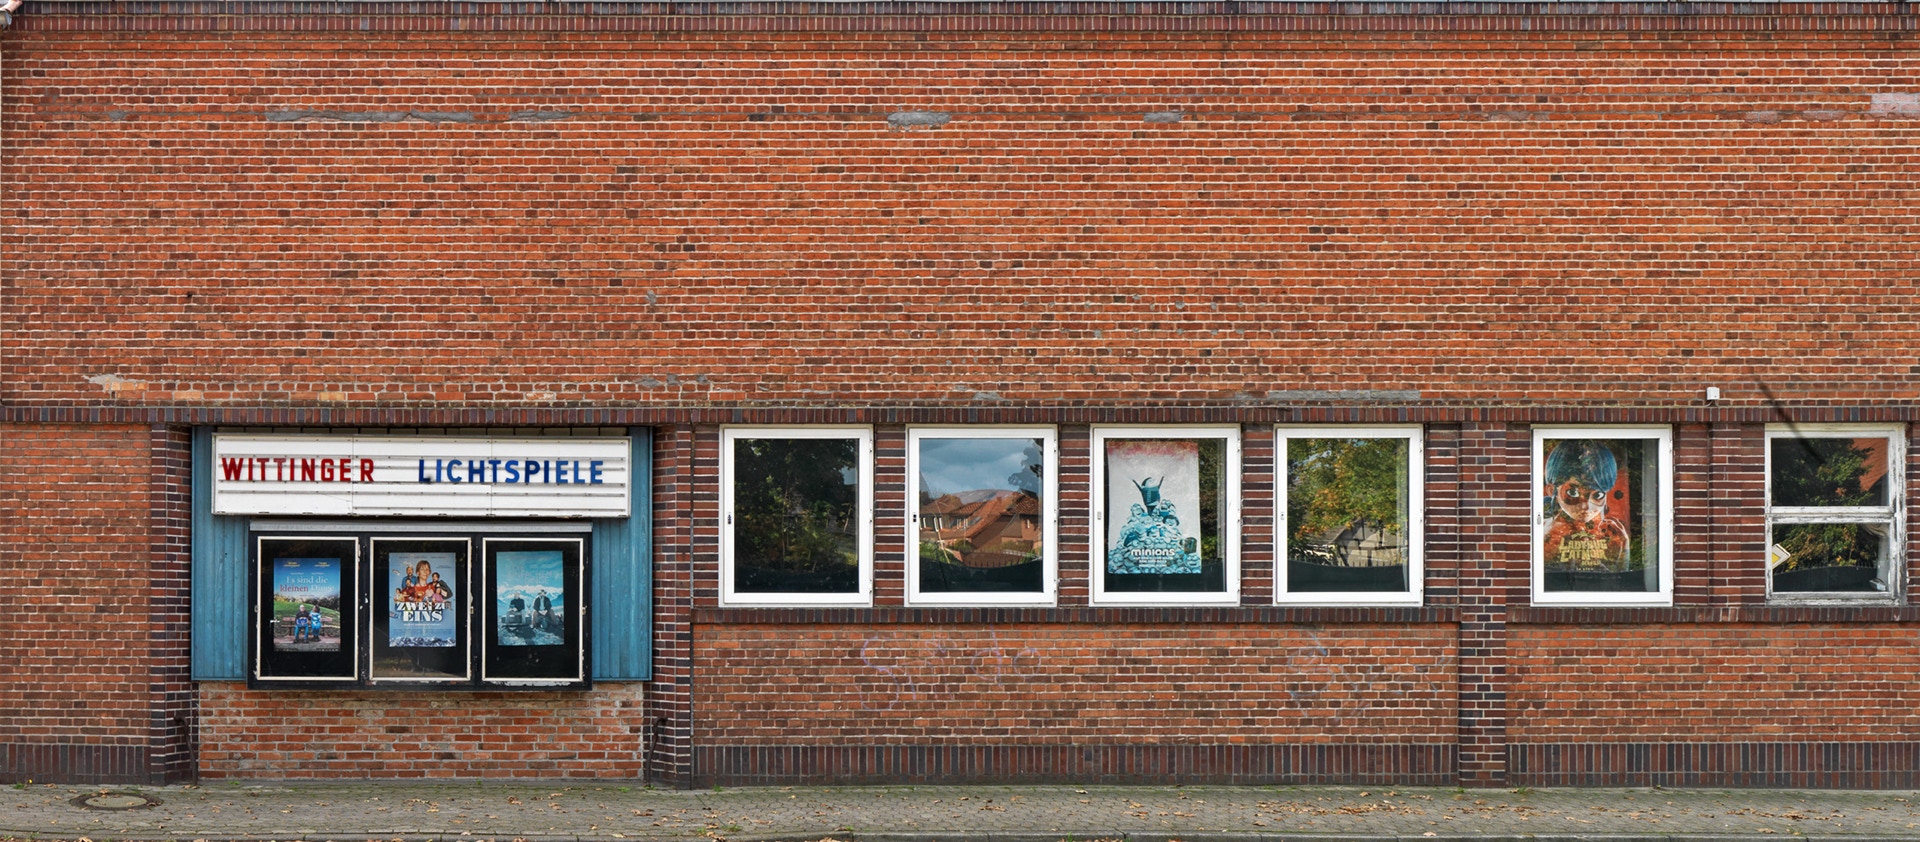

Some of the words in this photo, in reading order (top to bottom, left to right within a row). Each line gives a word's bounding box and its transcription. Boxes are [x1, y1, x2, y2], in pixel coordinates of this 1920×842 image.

[221, 457, 375, 483] WITTINGER
[418, 458, 604, 484] LICHTSPIELE
[1559, 537, 1608, 549] LADYBUG
[1130, 548, 1176, 556] minions
[286, 576, 295, 584] Es
[296, 575, 314, 584] sind
[315, 575, 329, 584] die
[280, 584, 309, 592] kleinen
[397, 602, 432, 611] ZWEI
[403, 611, 443, 622] EINS
